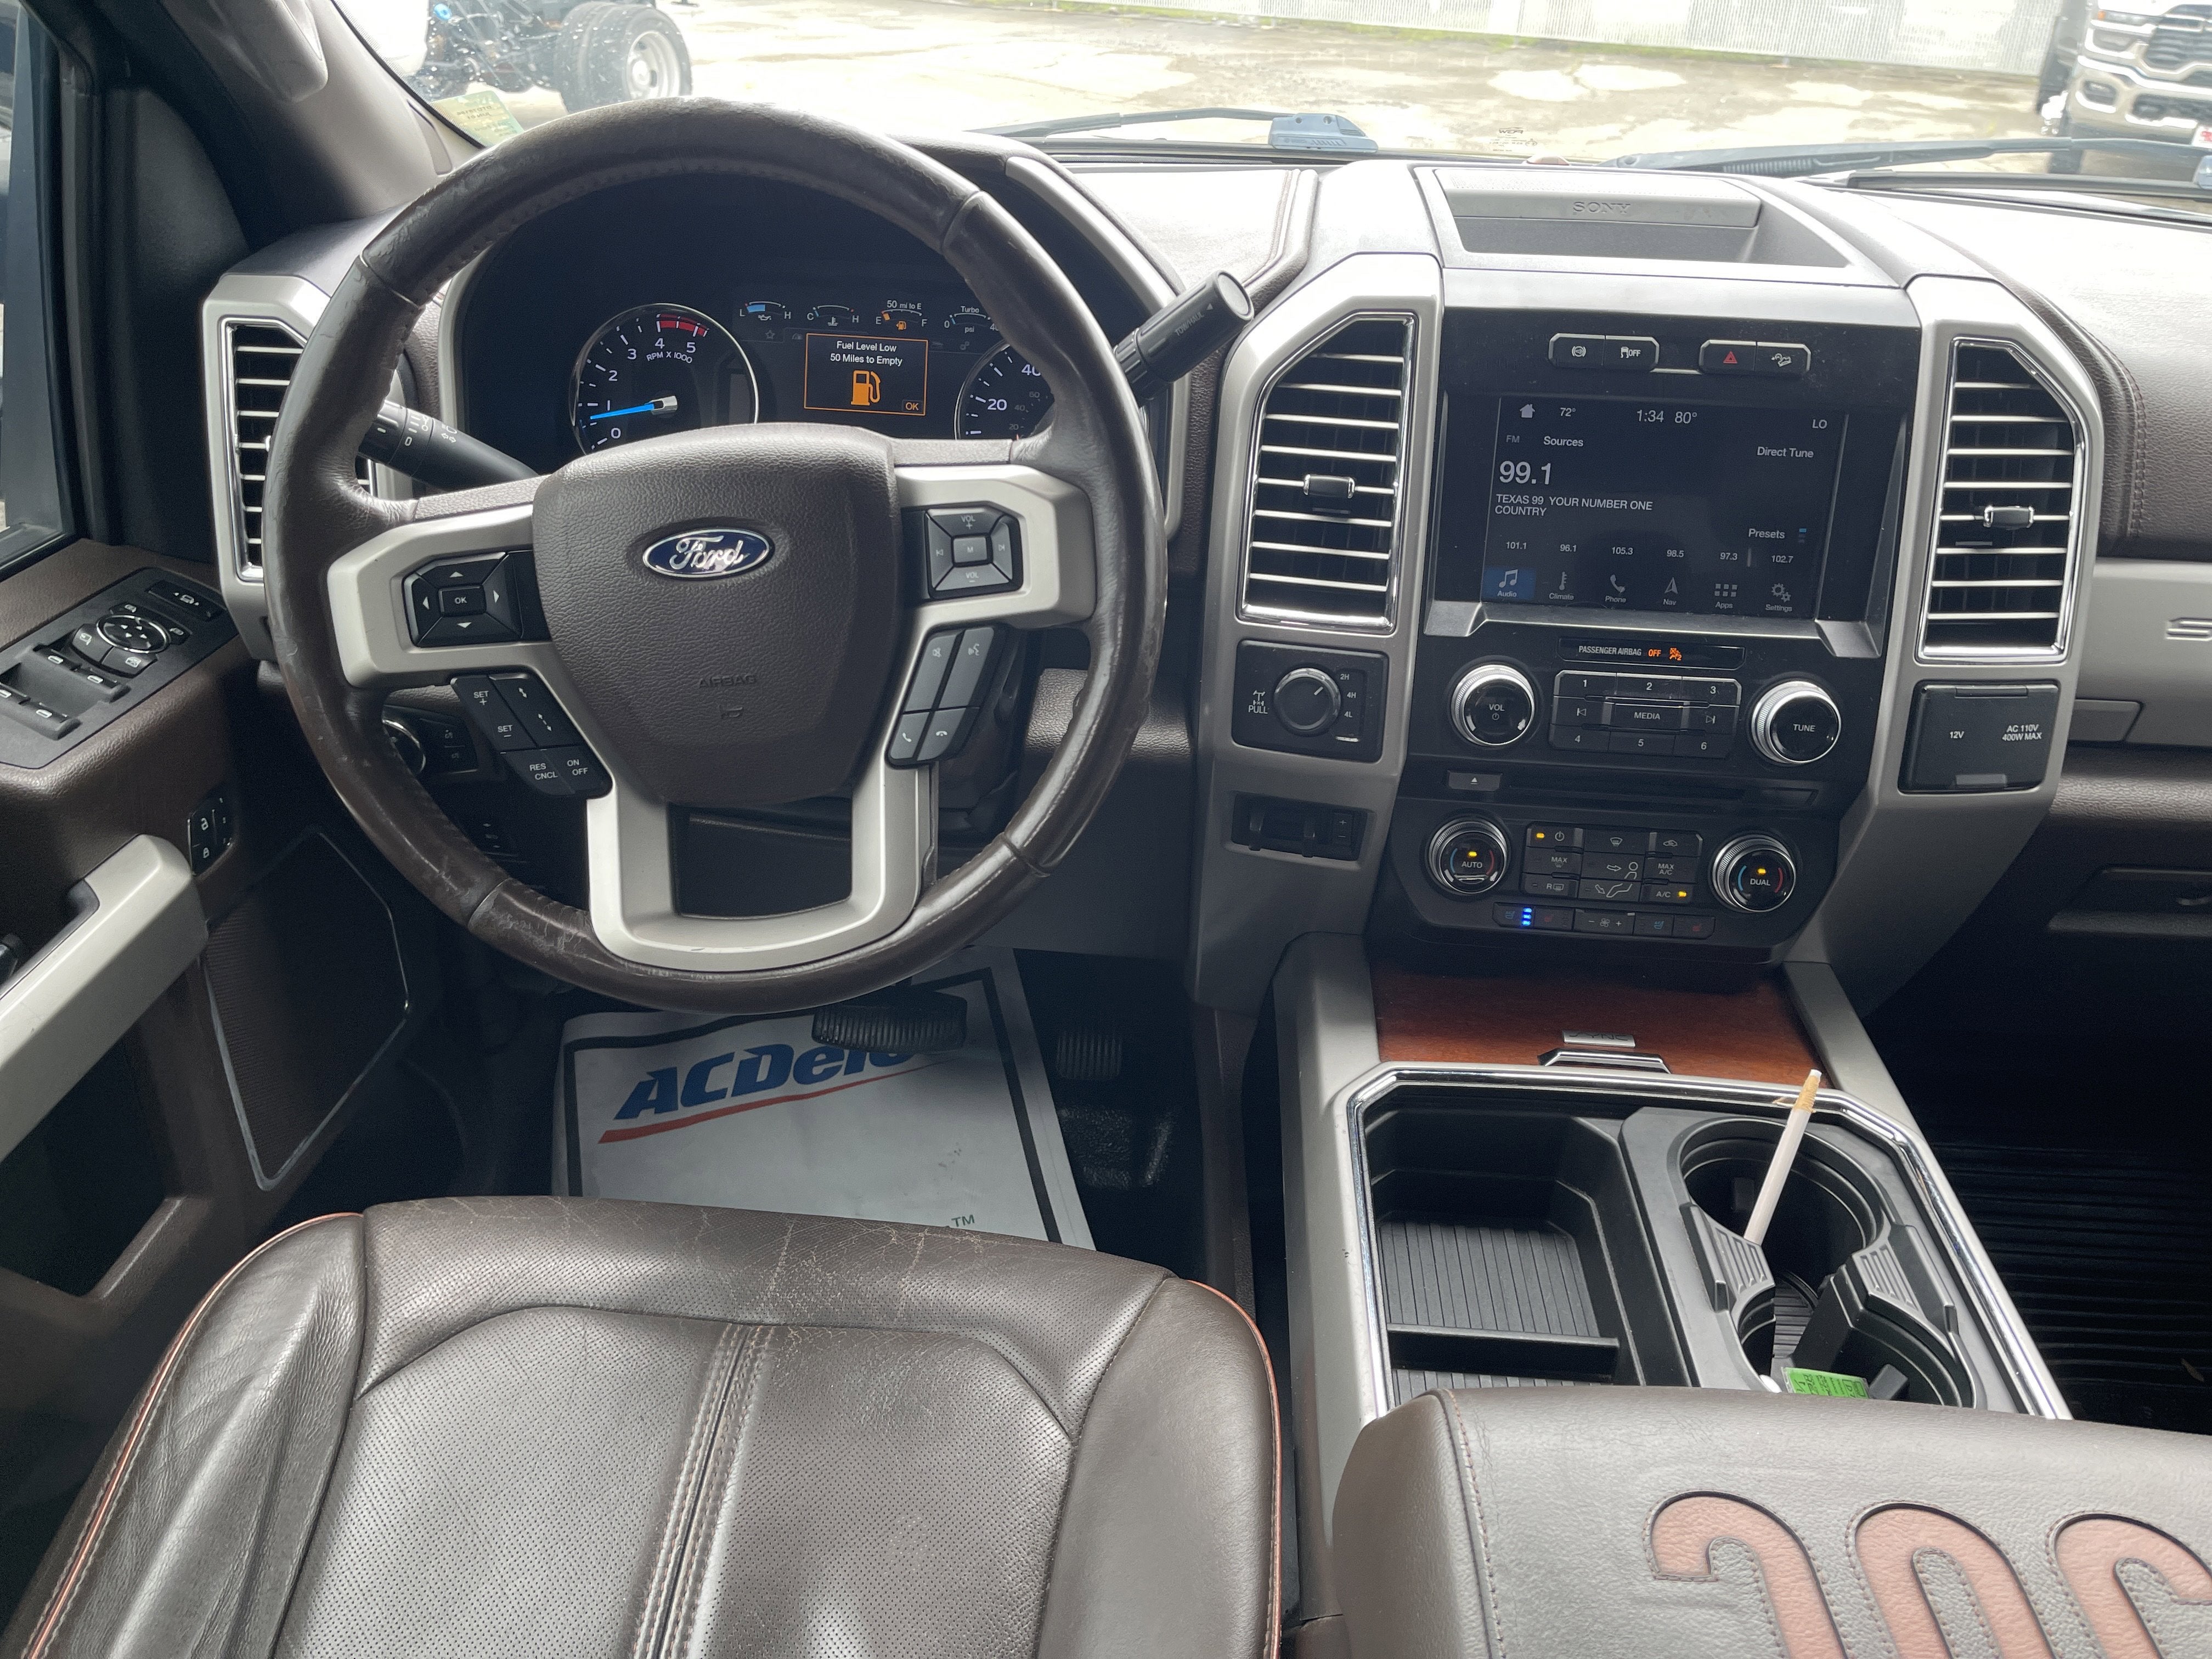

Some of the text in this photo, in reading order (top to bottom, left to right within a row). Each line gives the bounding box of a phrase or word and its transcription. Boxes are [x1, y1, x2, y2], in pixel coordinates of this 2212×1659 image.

[1573, 202, 1630, 213] SONY
[740, 308, 744, 317] L
[1175, 312, 1204, 336] TOW/HAUL
[655, 338, 664, 349] 4
[687, 342, 696, 353] 5
[837, 341, 854, 349] Fuel
[856, 342, 877, 351] Level
[628, 349, 637, 359] 3
[647, 352, 663, 361] RPM
[674, 353, 692, 363] 1000
[830, 353, 840, 362] 50
[843, 354, 864, 363] Miles
[877, 356, 902, 366] Empty
[608, 371, 618, 381] 2
[906, 402, 919, 410] OK
[988, 399, 1007, 410] 20
[1560, 408, 1576, 416] 72°
[1637, 409, 1697, 424] 1:34 80°
[1813, 419, 1827, 429] LO
[611, 428, 621, 439] 0
[1543, 436, 1584, 447] Sources
[1757, 447, 1814, 458] Direct Tune
[1499, 461, 1551, 485] 99.1
[1496, 494, 1652, 511] TEXAS 99 YOUR NUMBER ONE
[1495, 505, 1547, 516] COUNTRY
[1748, 529, 1785, 539] Presets
[669, 535, 751, 569] Ford
[1720, 552, 1737, 561] 97.3
[1771, 555, 1793, 563] 102.7
[1579, 646, 1616, 655] PASSENGER
[1618, 647, 1641, 656] AIRBAG
[699, 675, 757, 688] AIRBAG
[1249, 705, 1268, 714] PULL
[1793, 724, 1816, 732] TUNE
[1569, 1032, 1628, 1041] SYNC
[951, 1214, 974, 1227] TM
